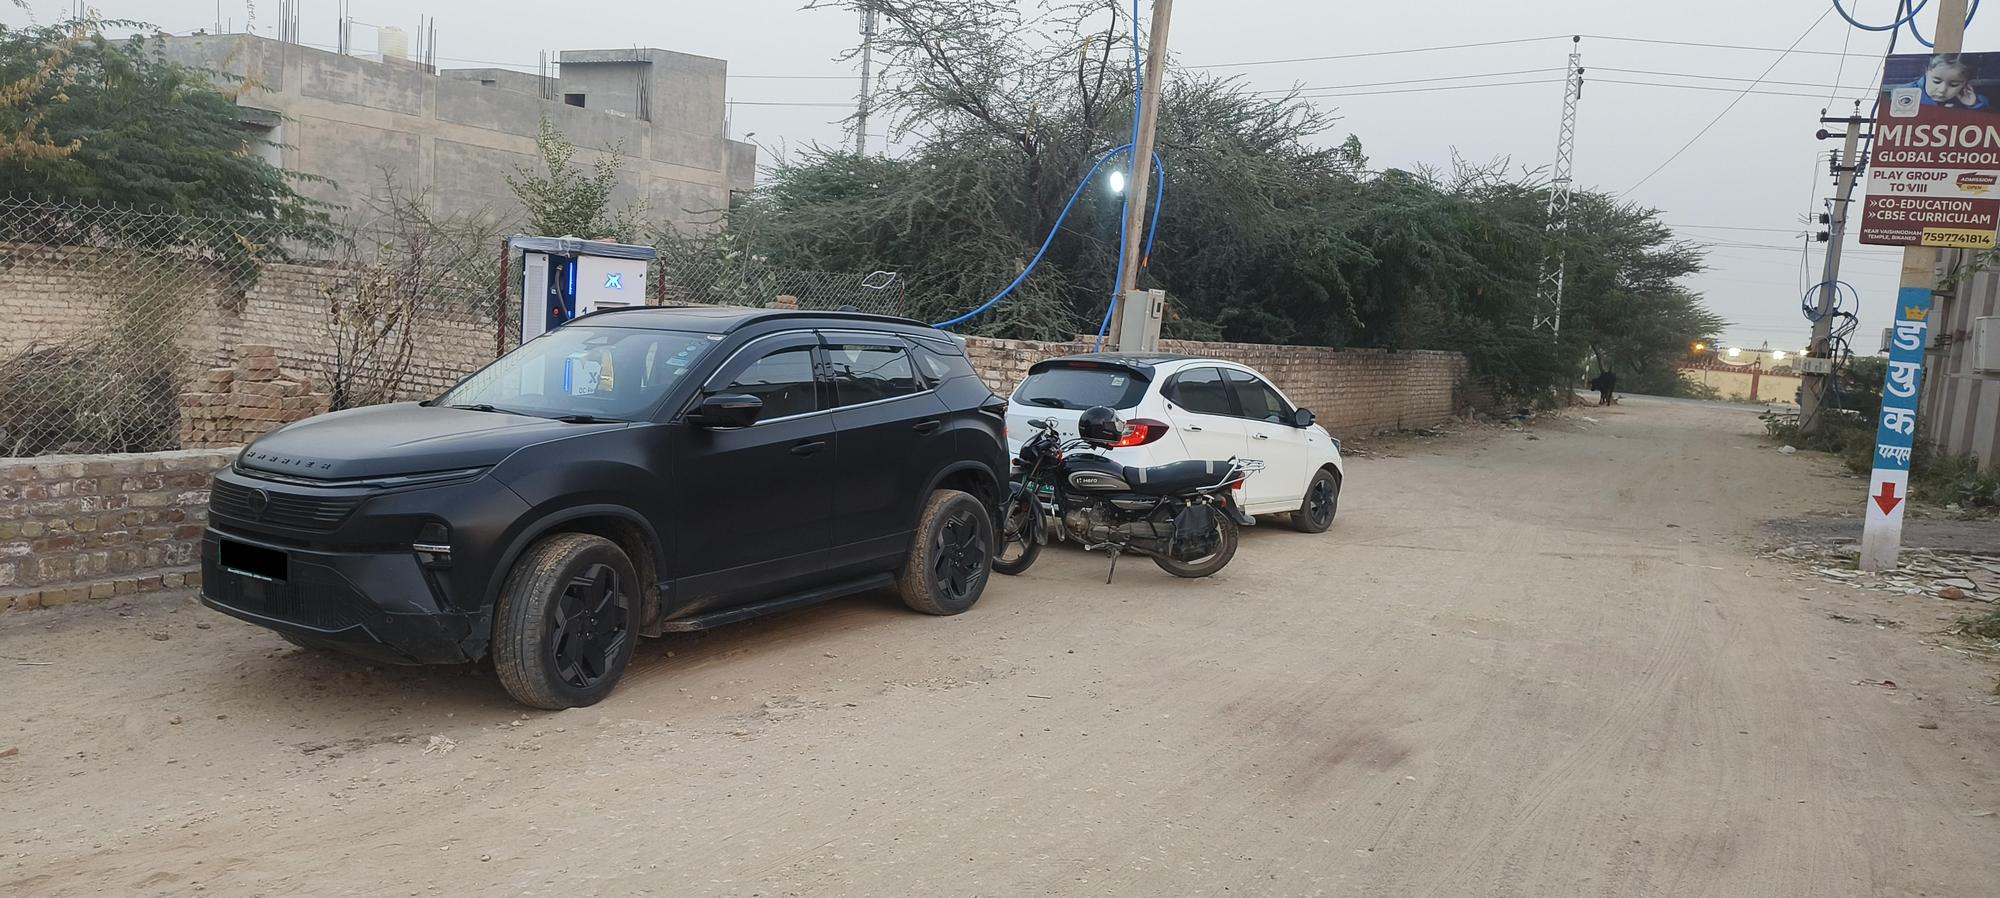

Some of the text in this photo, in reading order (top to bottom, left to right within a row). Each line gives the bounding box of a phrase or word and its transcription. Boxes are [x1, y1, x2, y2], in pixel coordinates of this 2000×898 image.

[1877, 124, 2000, 148] MISSION
[1878, 150, 1999, 164] GLOBAL SCHOOL
[1873, 170, 1948, 181] PLAY GROUP
[1889, 183, 1928, 193] TO VIII
[1878, 198, 1972, 212] CO-EDUCATION
[1876, 210, 1991, 224] CBSE CURRICULAM
[1923, 232, 1990, 245] 7597741814
